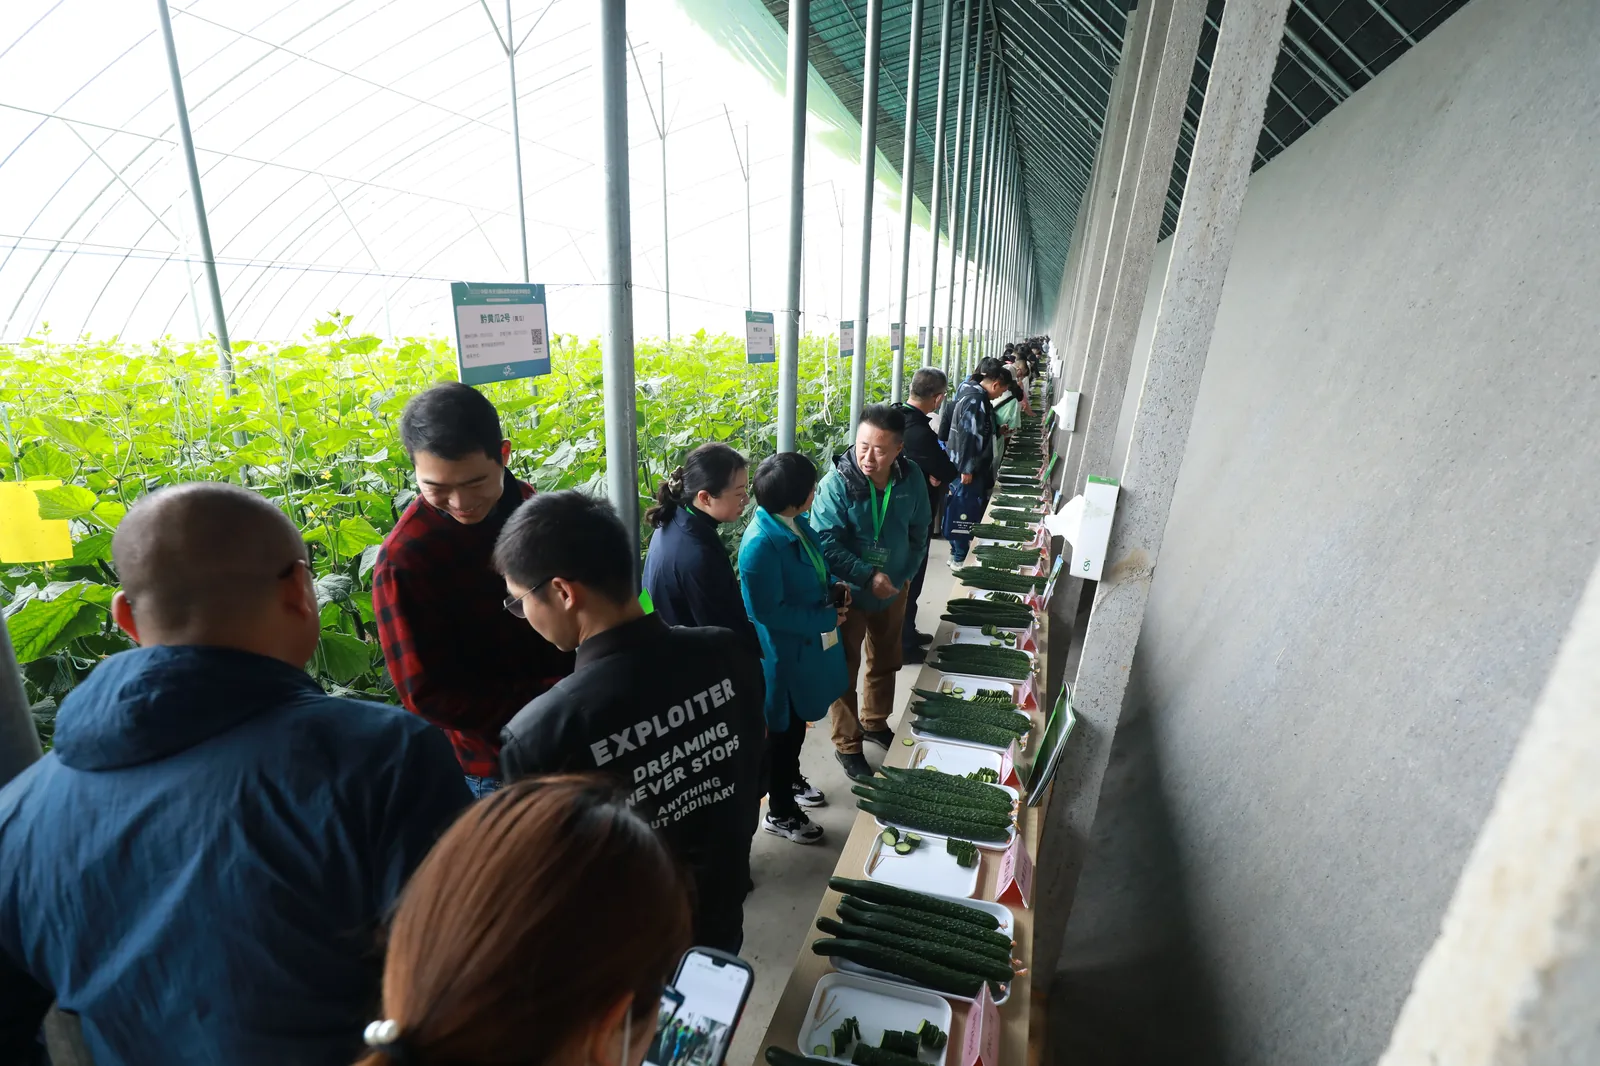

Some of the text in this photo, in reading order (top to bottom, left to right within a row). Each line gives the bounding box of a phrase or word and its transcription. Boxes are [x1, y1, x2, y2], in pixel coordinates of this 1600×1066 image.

[589, 678, 736, 767] EXPLOITER
[633, 722, 729, 784] DREAMING
[625, 734, 740, 808] NEVER STOPS
[657, 776, 722, 816] ANYTHING
[651, 783, 736, 829] UT ORDINARY
